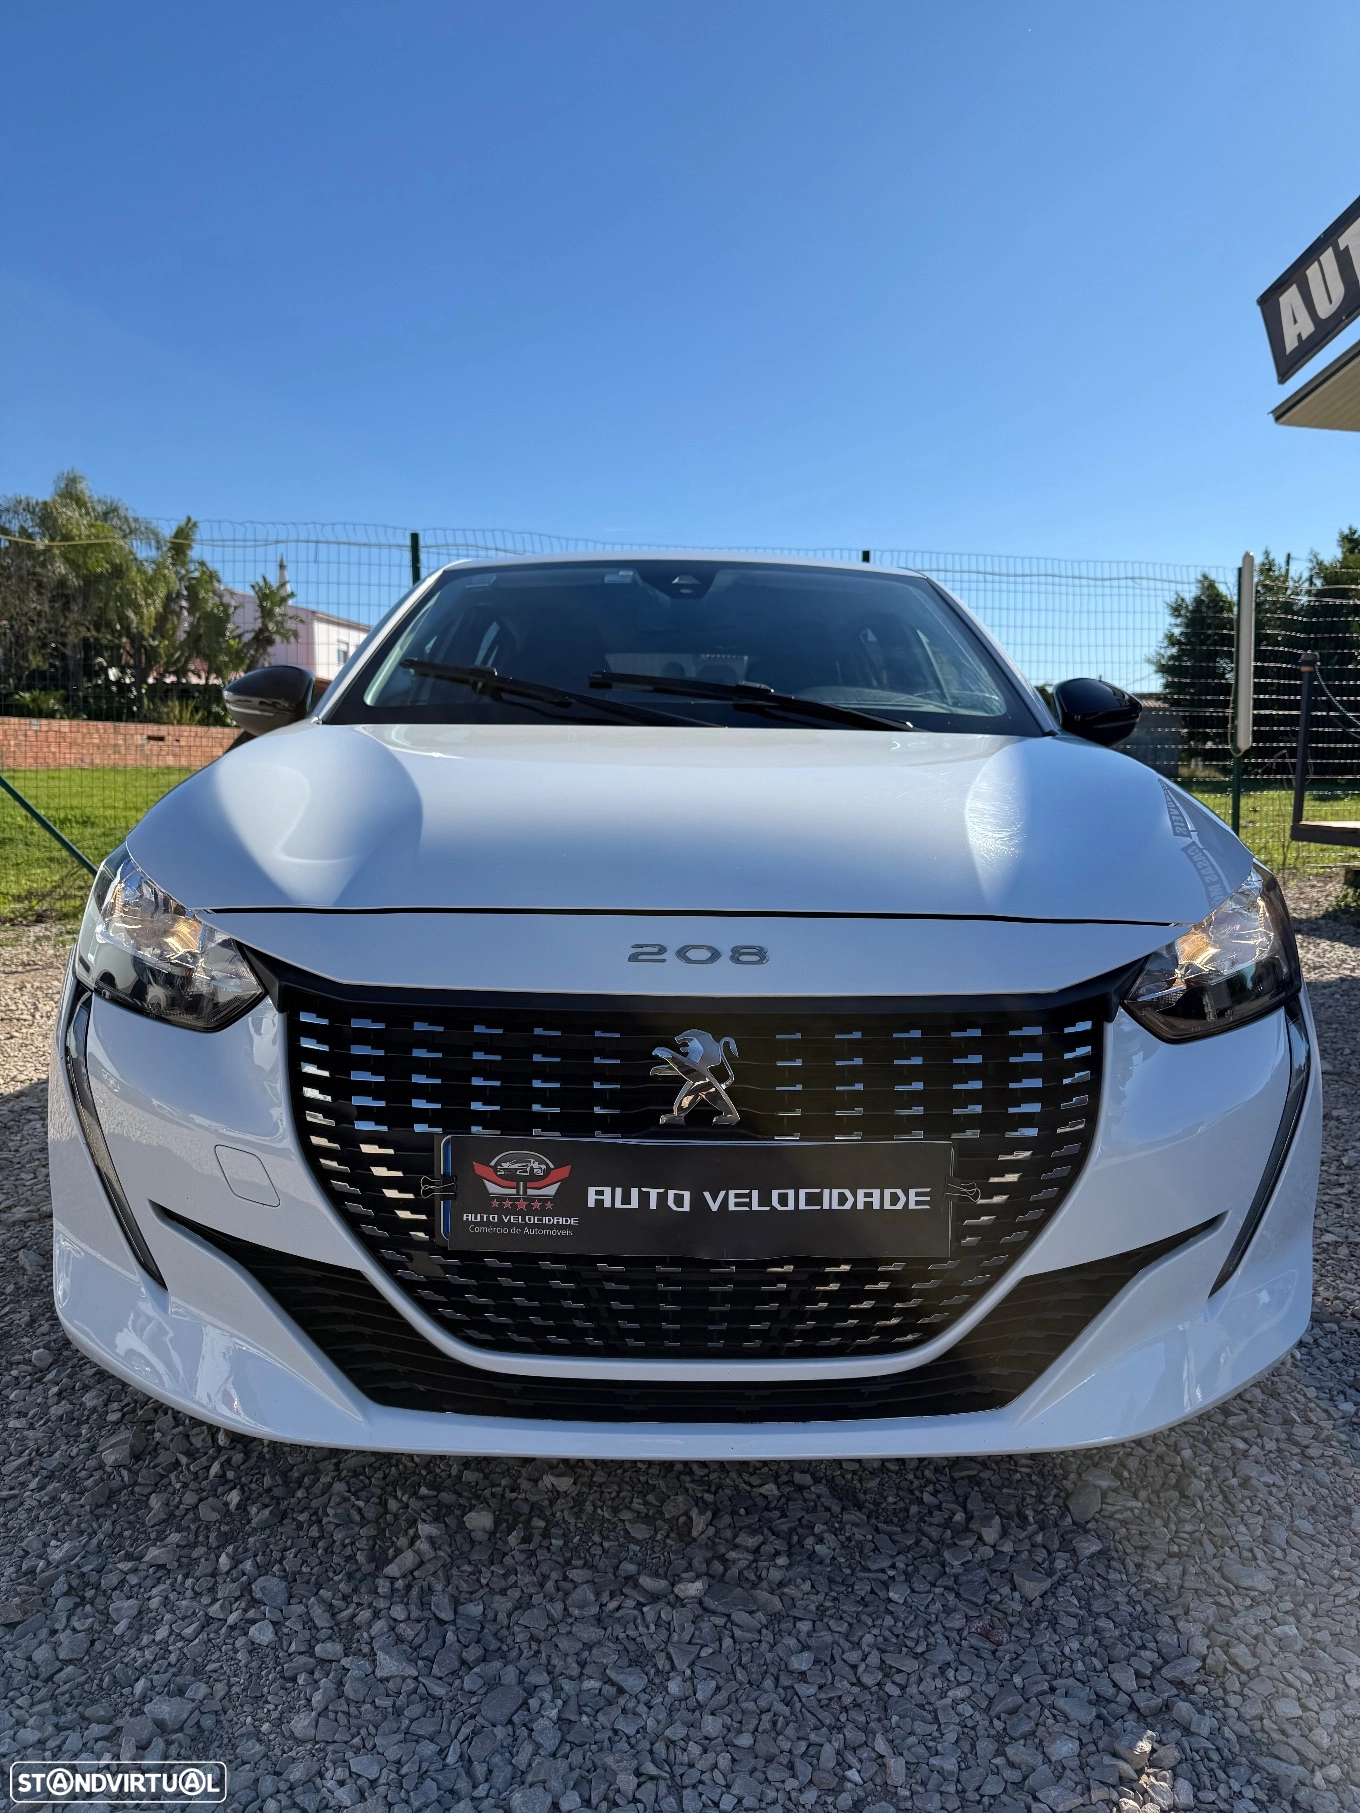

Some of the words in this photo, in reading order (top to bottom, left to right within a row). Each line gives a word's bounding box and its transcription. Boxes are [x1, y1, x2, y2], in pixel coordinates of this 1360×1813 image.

[627, 943, 770, 966] 208
[587, 1186, 691, 1212] AUTO
[702, 1187, 932, 1212] VELOCIDADE
[463, 1213, 498, 1223] AUTO
[502, 1214, 580, 1226] VELOCIDADE
[468, 1224, 509, 1235] Comércio
[510, 1226, 521, 1235] de
[523, 1226, 573, 1236] Automóveis
